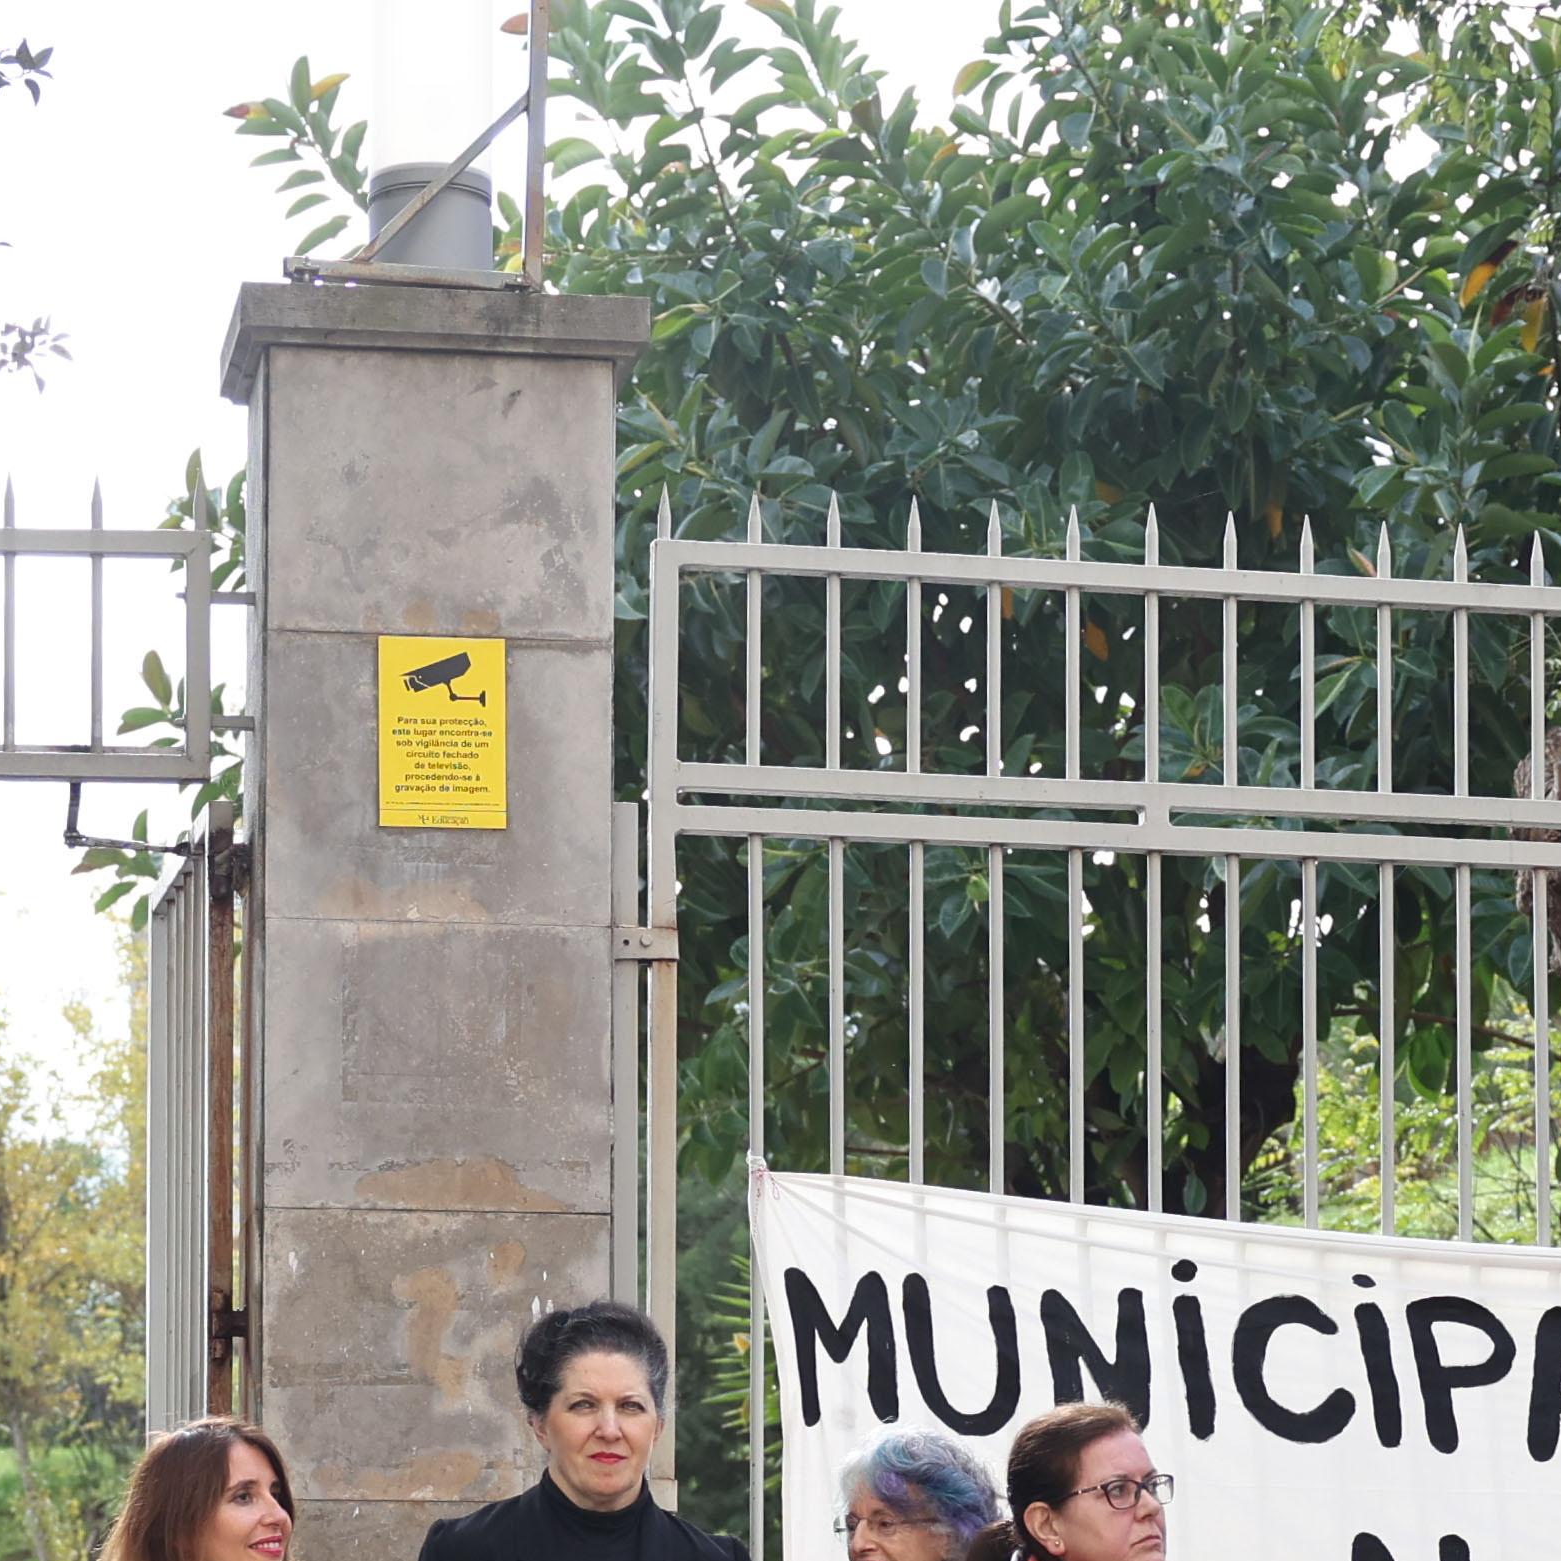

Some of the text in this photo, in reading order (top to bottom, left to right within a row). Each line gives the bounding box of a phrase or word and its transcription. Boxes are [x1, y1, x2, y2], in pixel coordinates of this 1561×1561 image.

[397, 716, 418, 724] Para
[439, 717, 487, 727] protecção,
[392, 728, 493, 737] este lugar encontra-se
[396, 739, 413, 747] sob
[415, 739, 458, 749] vigilância
[461, 740, 472, 748] de
[406, 750, 479, 759] circuito fechado
[414, 761, 471, 771] de televisão,
[405, 773, 473, 782] procedendo-se
[394, 784, 491, 794] gravação de imagem.
